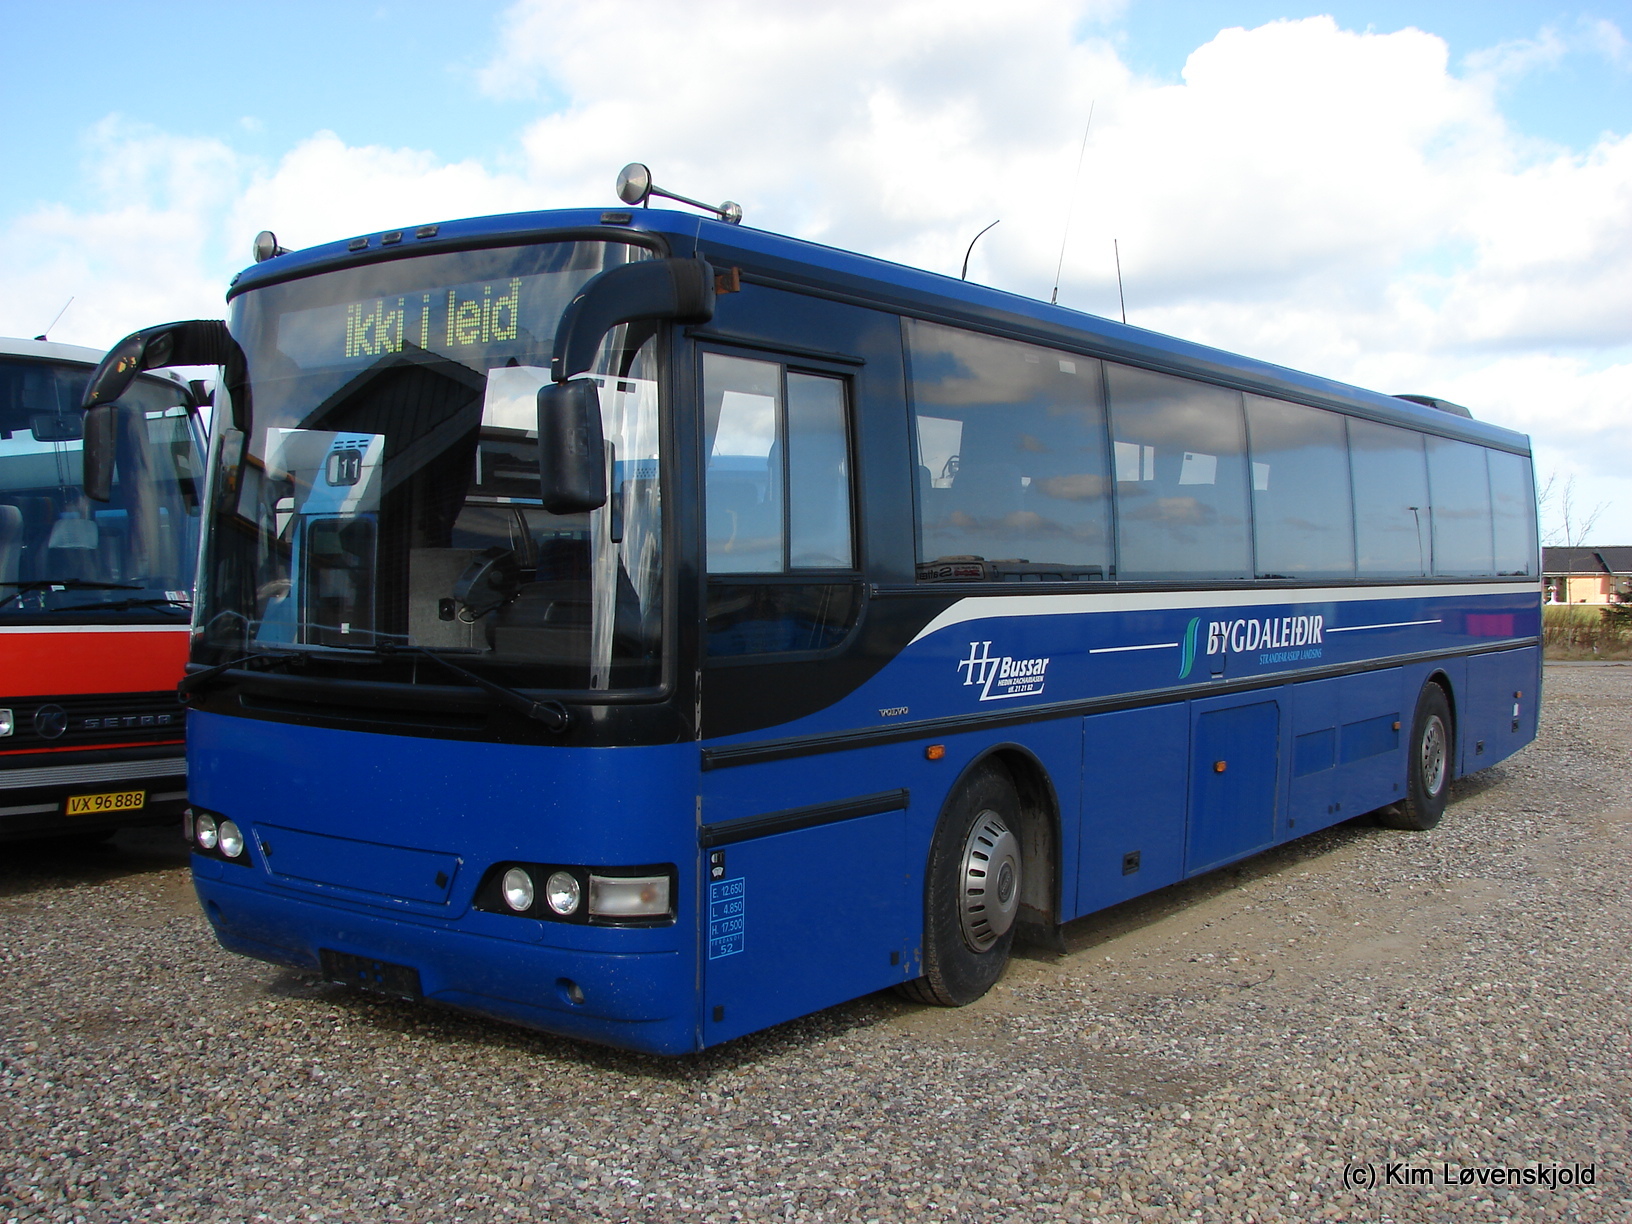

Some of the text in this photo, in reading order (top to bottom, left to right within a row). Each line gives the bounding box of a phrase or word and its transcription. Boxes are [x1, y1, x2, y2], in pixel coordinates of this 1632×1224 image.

[345, 297, 404, 358] ikki
[1206, 615, 1323, 656] BYGDALEIÐIR
[999, 656, 1050, 678] Bussar
[878, 706, 909, 717] VOLVO
[85, 714, 172, 729] SETRA
[71, 792, 143, 812] VX 96 888
[721, 882, 743, 896] 12.650
[723, 901, 743, 915] 4.850
[721, 918, 743, 933] 17.500
[720, 943, 733, 955] 52
